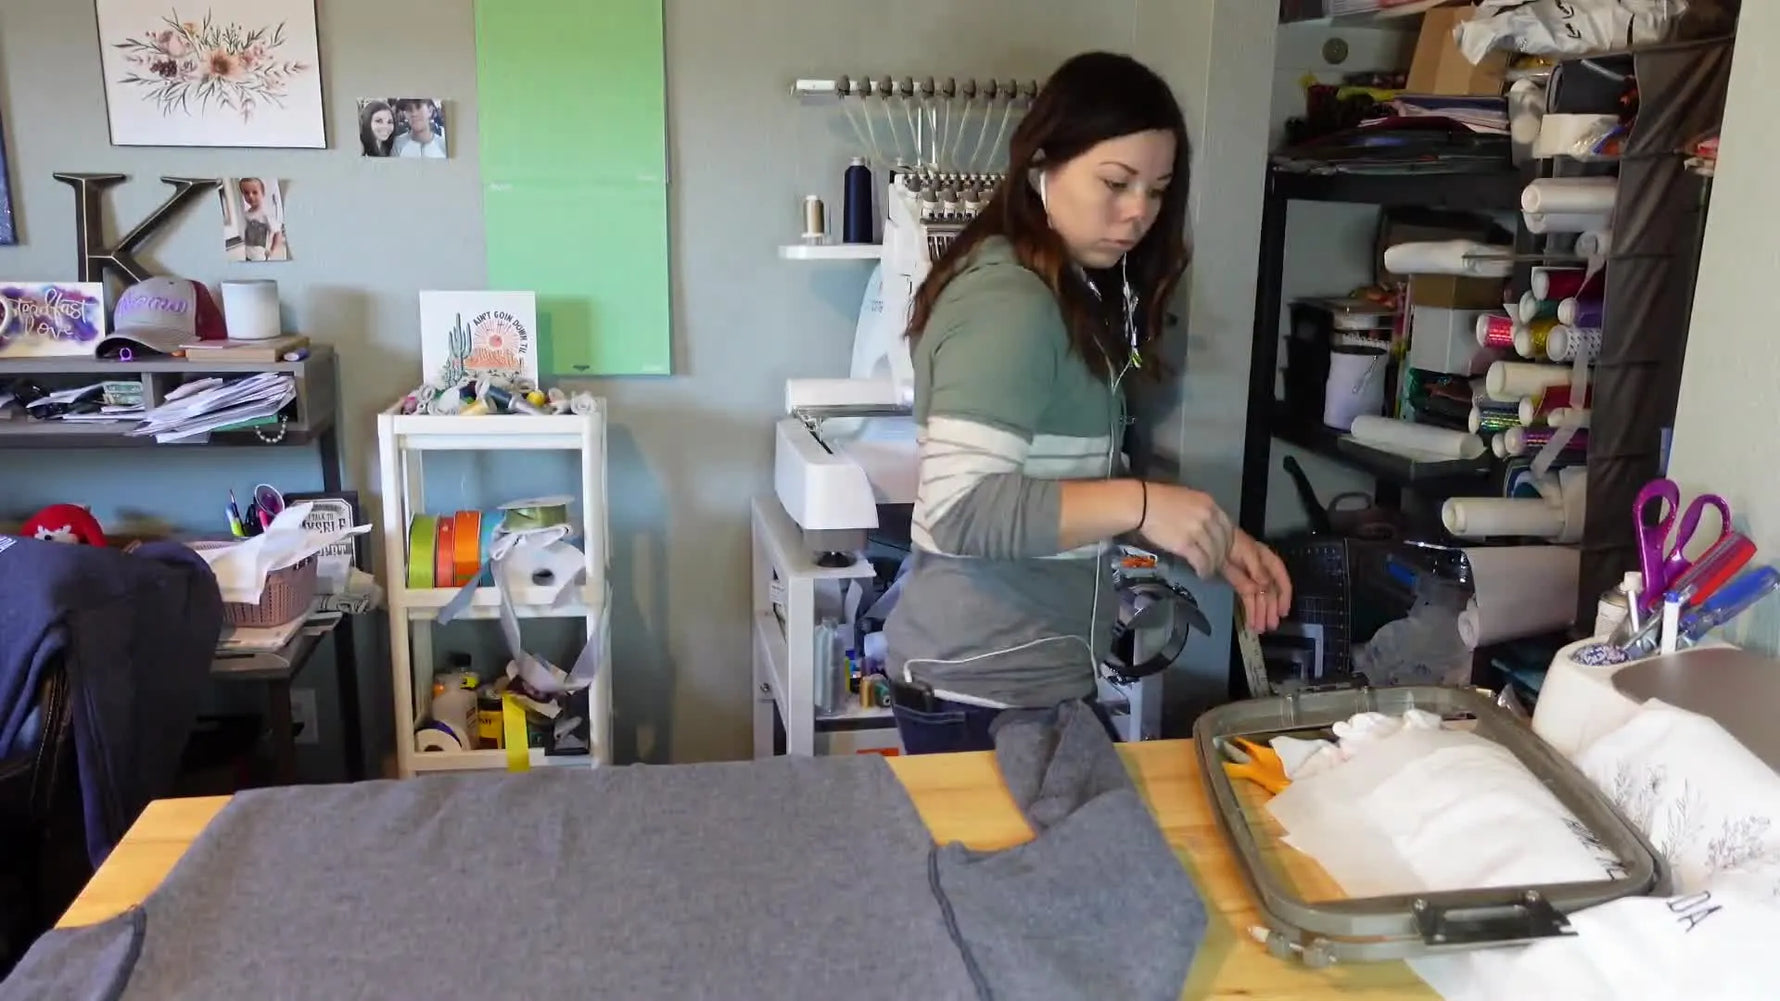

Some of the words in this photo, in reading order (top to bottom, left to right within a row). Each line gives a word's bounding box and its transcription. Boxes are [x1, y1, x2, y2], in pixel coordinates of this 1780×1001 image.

[0, 288, 97, 334] teadfast
[472, 310, 492, 327] AIN'T
[494, 310, 514, 323] GOIN
[512, 319, 528, 341] DOWN
